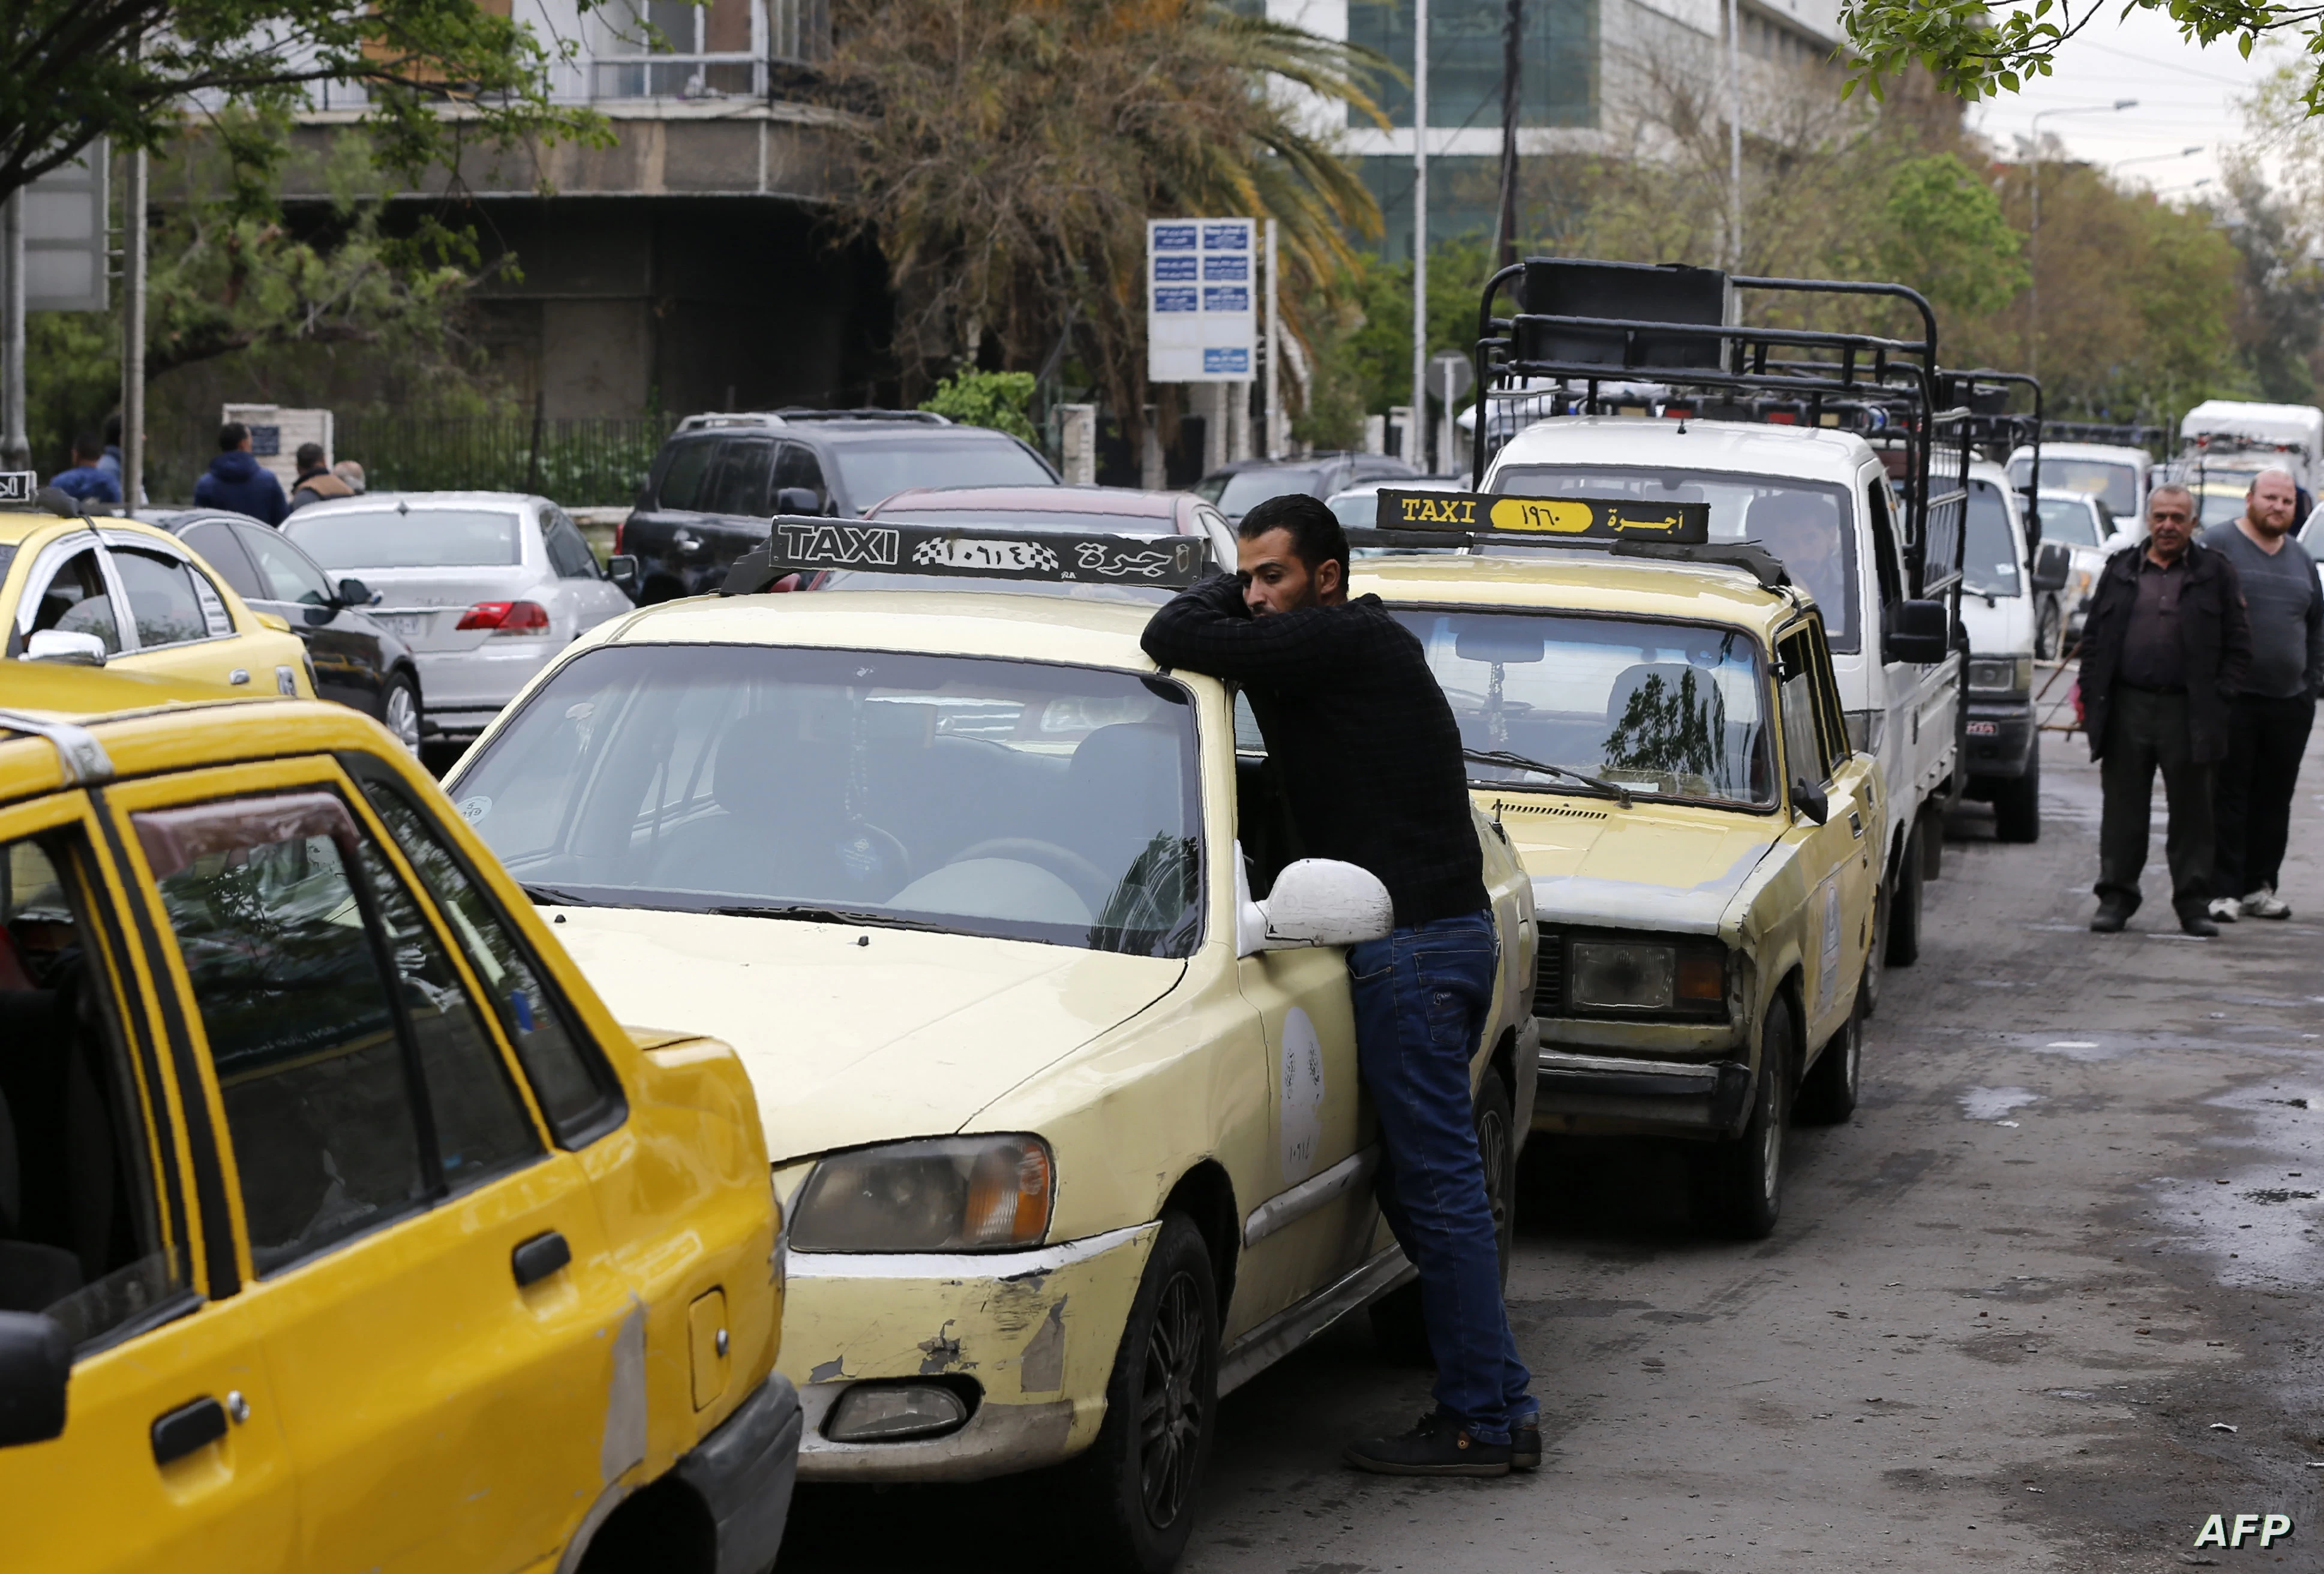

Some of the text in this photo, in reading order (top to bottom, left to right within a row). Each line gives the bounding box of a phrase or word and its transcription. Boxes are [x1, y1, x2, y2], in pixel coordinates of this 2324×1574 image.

[1401, 498, 1476, 523] TAXI
[1521, 504, 1560, 526] ١٩٦٠
[1607, 508, 1683, 534] أجرة
[778, 524, 899, 565] TAXI
